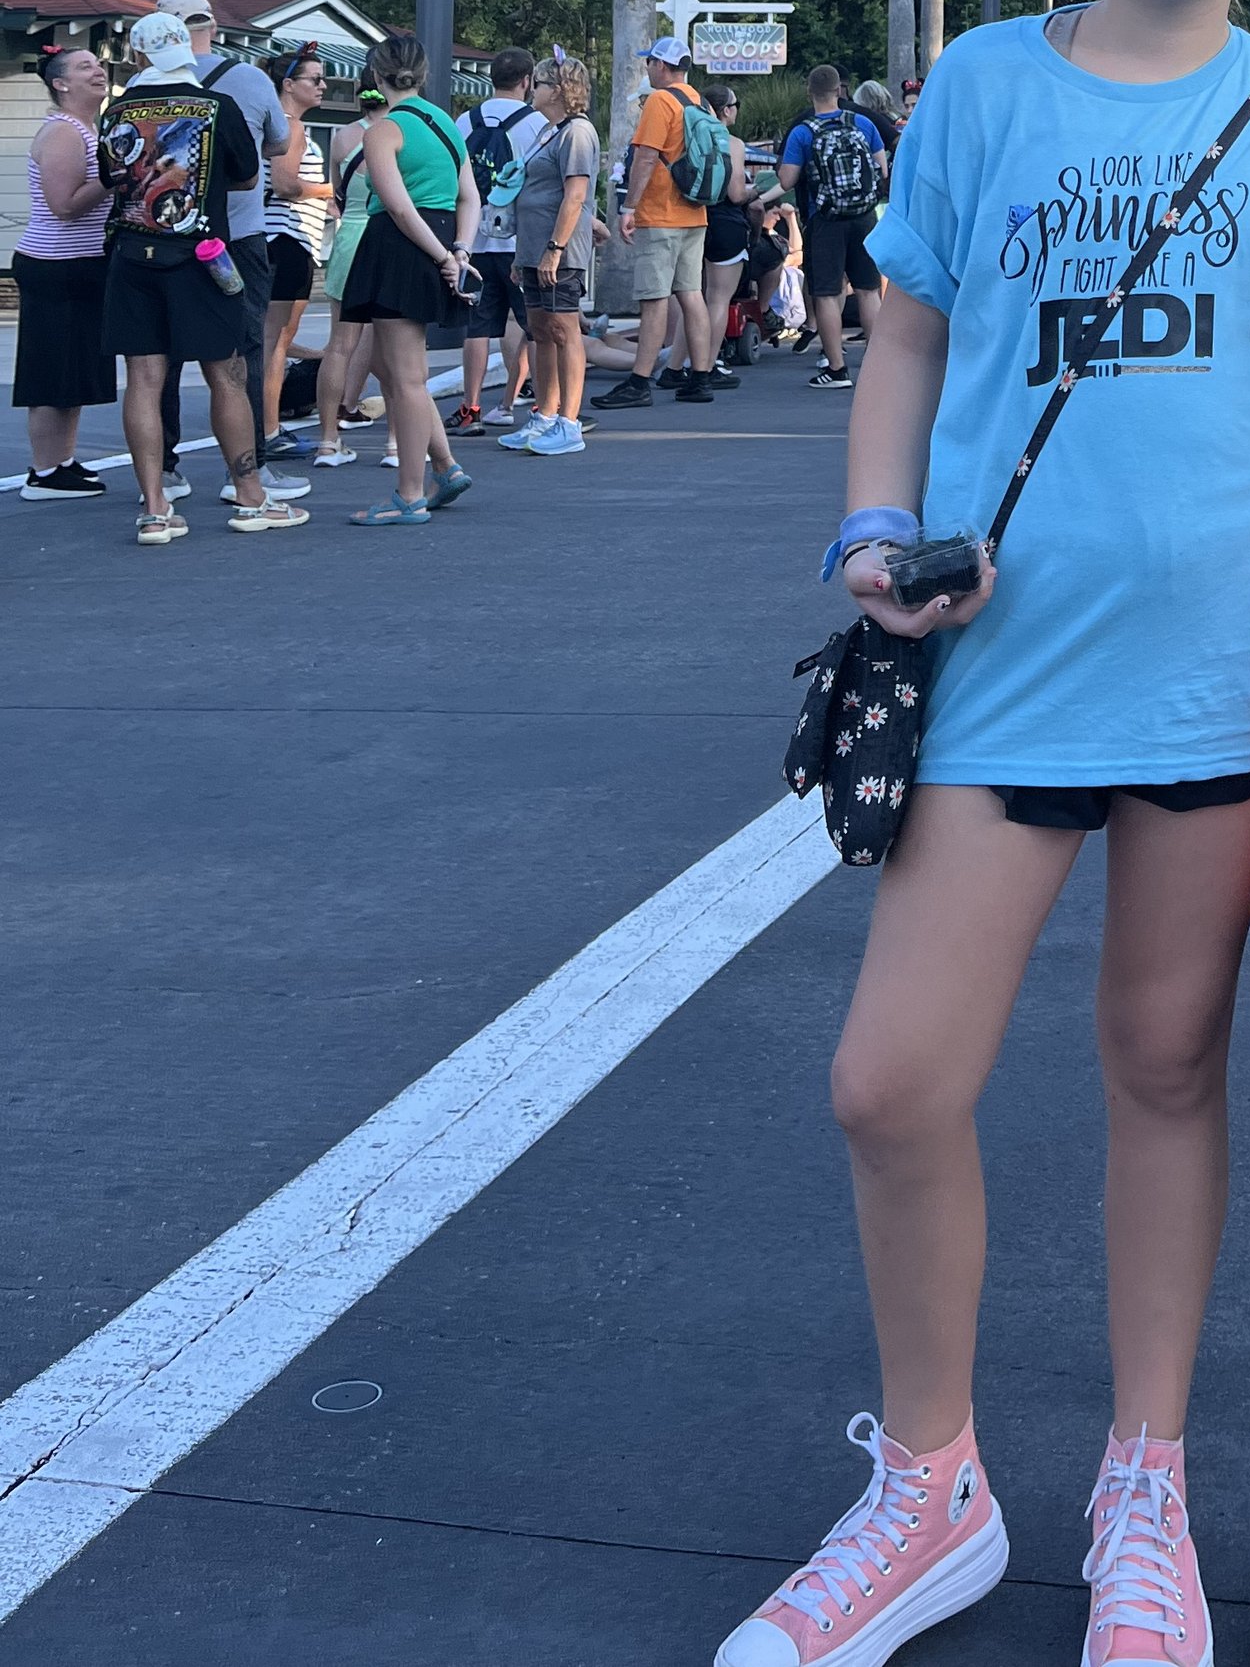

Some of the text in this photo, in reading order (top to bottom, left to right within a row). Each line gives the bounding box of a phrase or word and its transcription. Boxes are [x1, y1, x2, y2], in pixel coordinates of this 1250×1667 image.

[707, 25, 771, 34] HOLLYWOOD
[700, 41, 783, 59] SCOOPS
[710, 61, 769, 72] ICE CREAM
[120, 108, 150, 121] POD
[151, 104, 210, 118] RACING
[1089, 155, 1143, 187] LOOK
[1154, 151, 1194, 186] LIKE
[1059, 256, 1118, 294] FIGHT
[1182, 251, 1196, 287] A
[1026, 293, 1216, 387] JEDI
